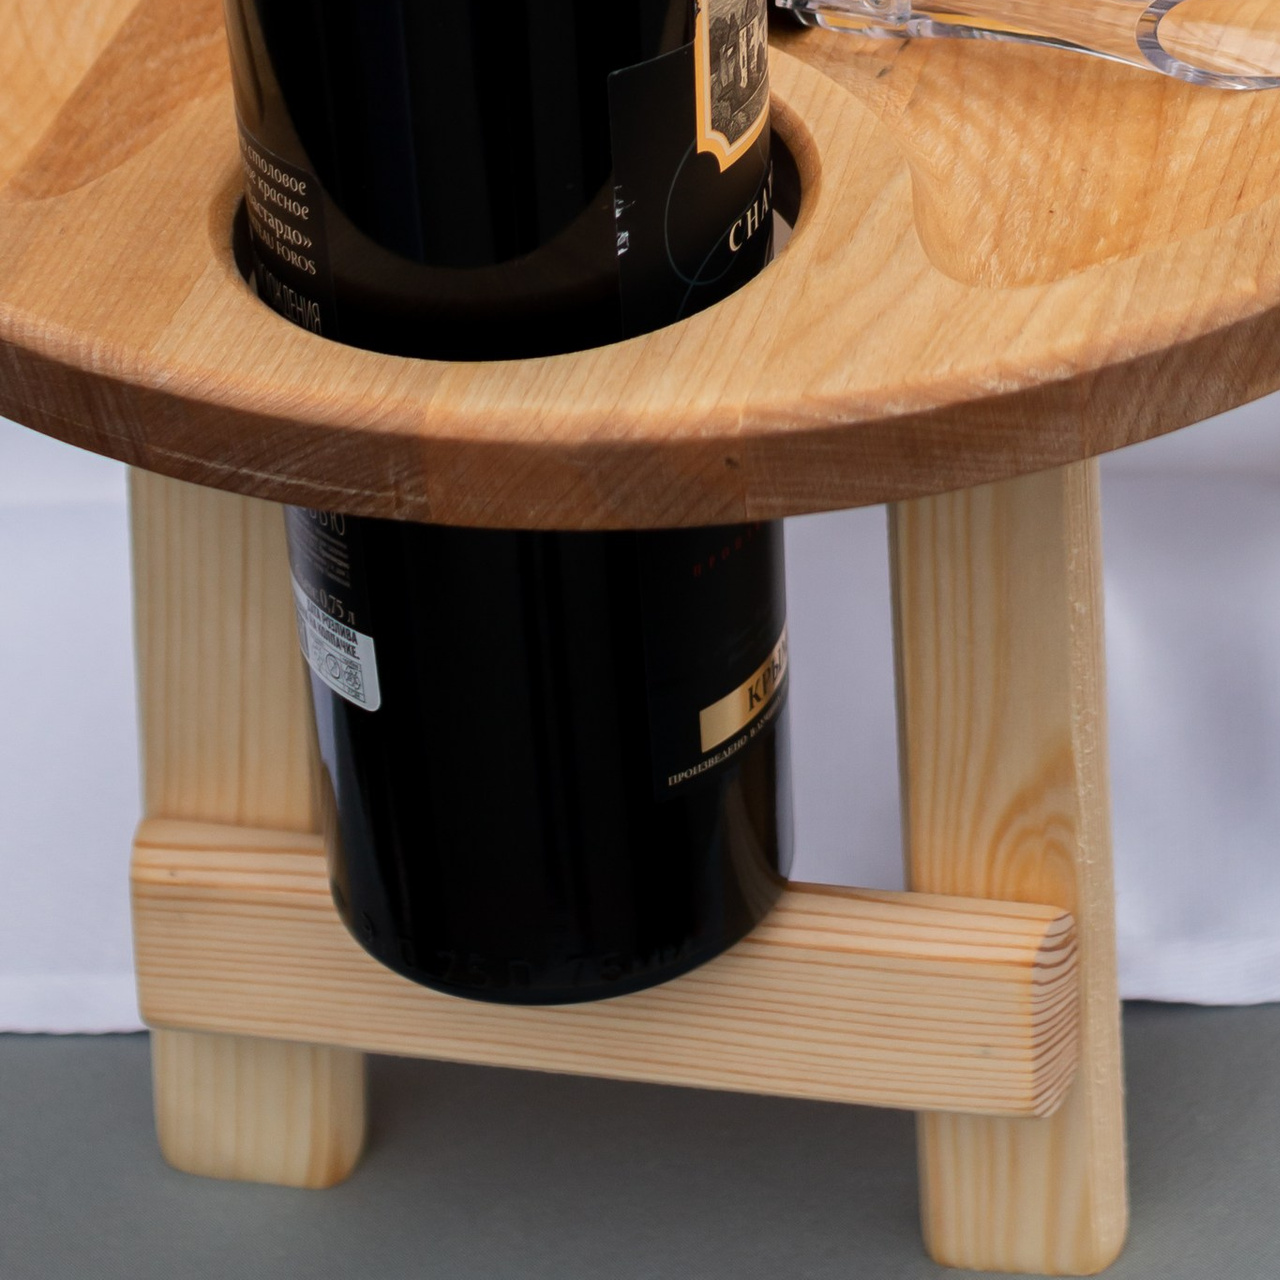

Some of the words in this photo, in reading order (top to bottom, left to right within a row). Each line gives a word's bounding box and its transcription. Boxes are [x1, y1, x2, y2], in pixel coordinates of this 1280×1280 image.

[247, 144, 307, 197] столовое
[257, 175, 310, 221] красное
[276, 239, 317, 276] FOROS
[319, 587, 345, 620] 0,75
[667, 734, 748, 787] ПРОИЗВЕДЕНО
